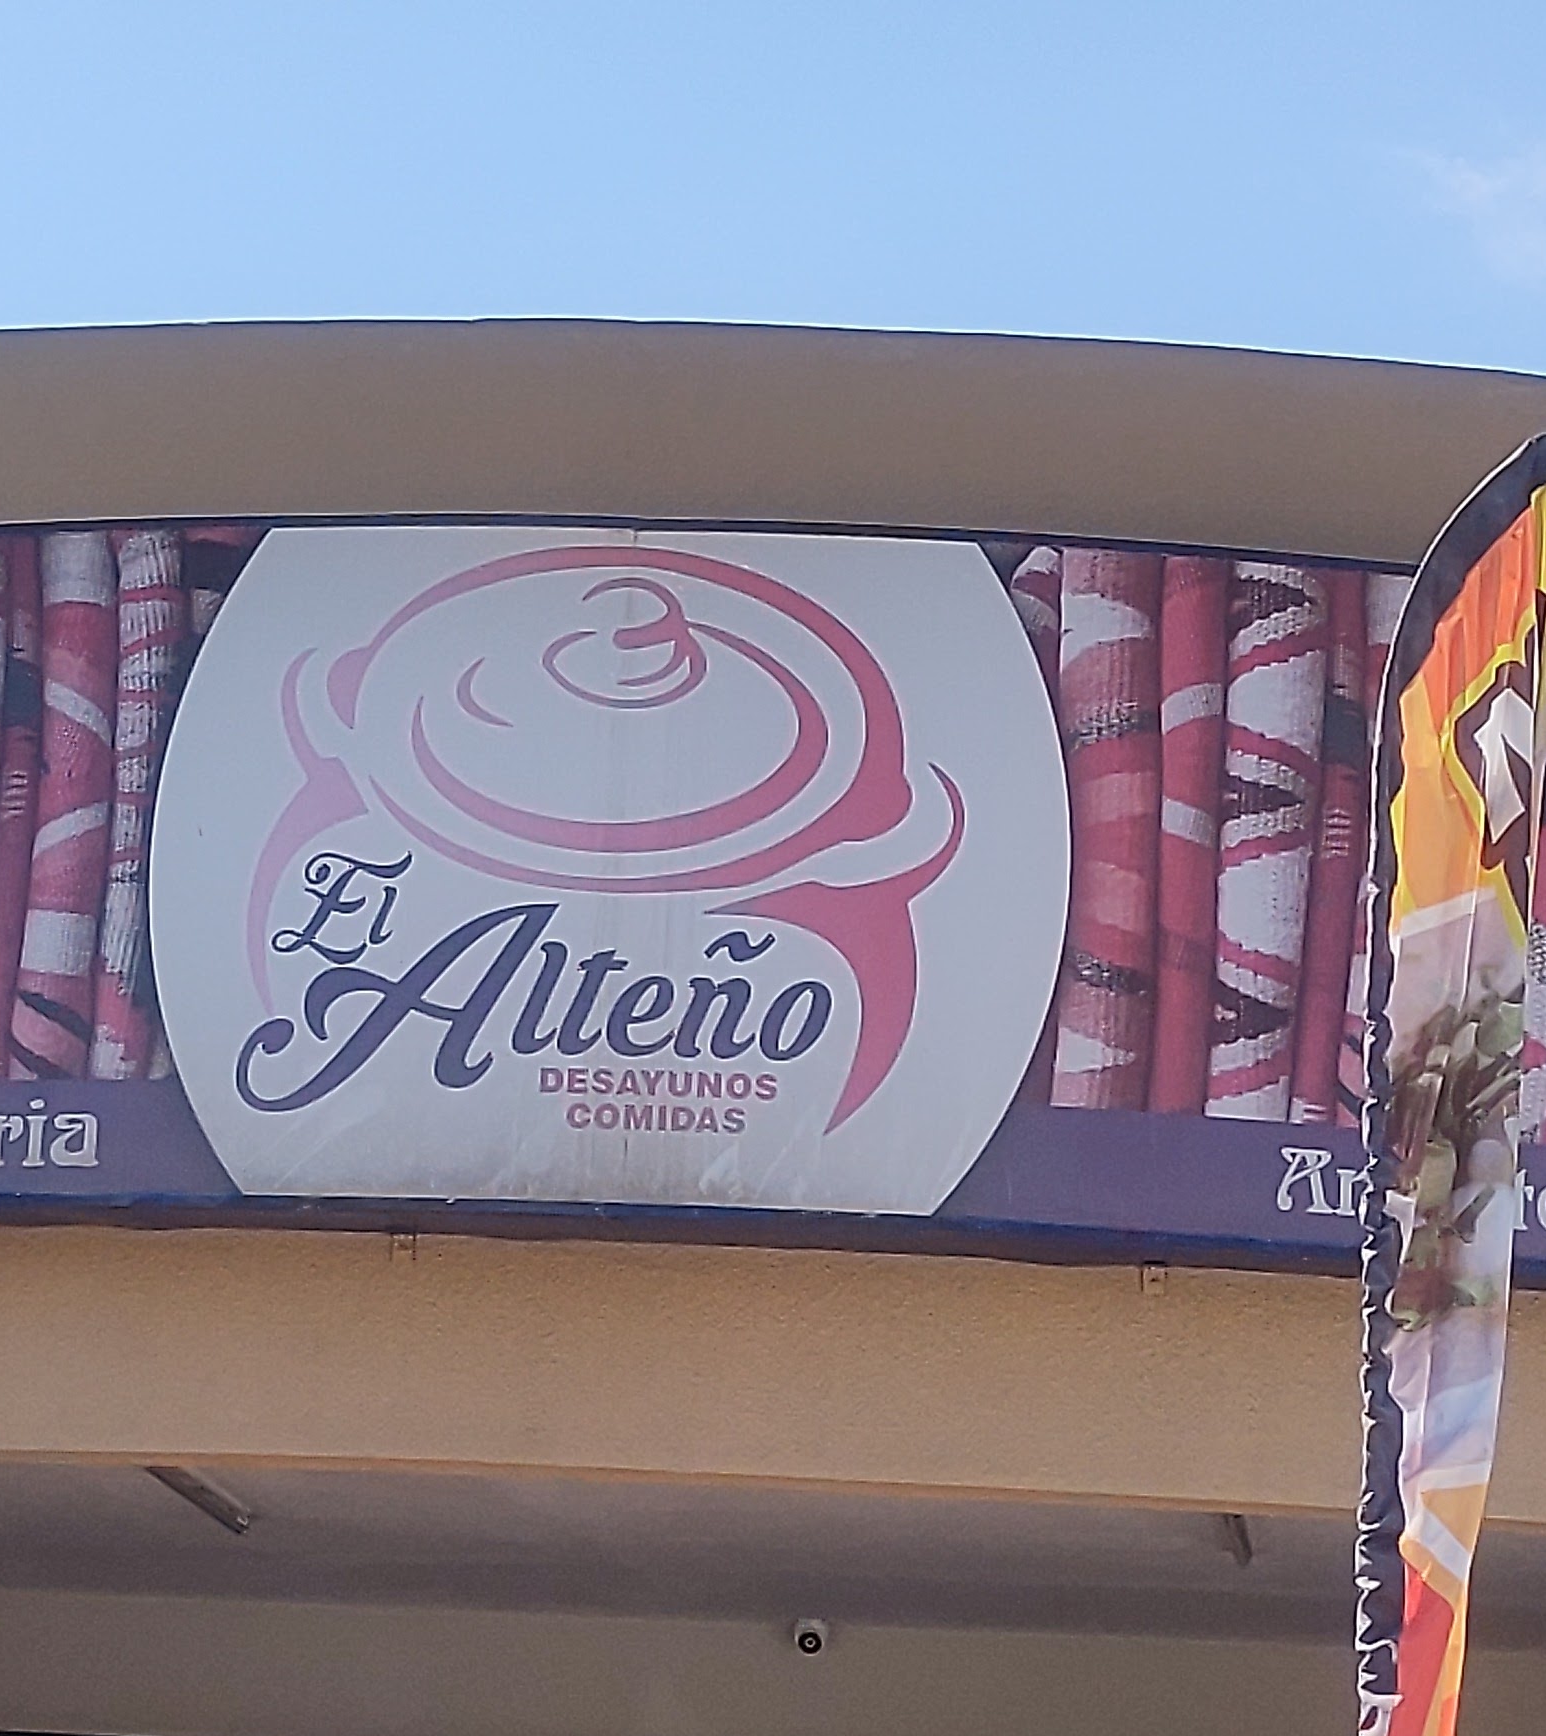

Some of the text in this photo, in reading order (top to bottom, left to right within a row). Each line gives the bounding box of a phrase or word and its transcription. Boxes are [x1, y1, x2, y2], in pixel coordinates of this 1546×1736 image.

[270, 849, 413, 964] El
[234, 902, 835, 1113] Alteño
[538, 1066, 779, 1101] DESAYUNOS
[565, 1101, 747, 1136] COMIDAS
